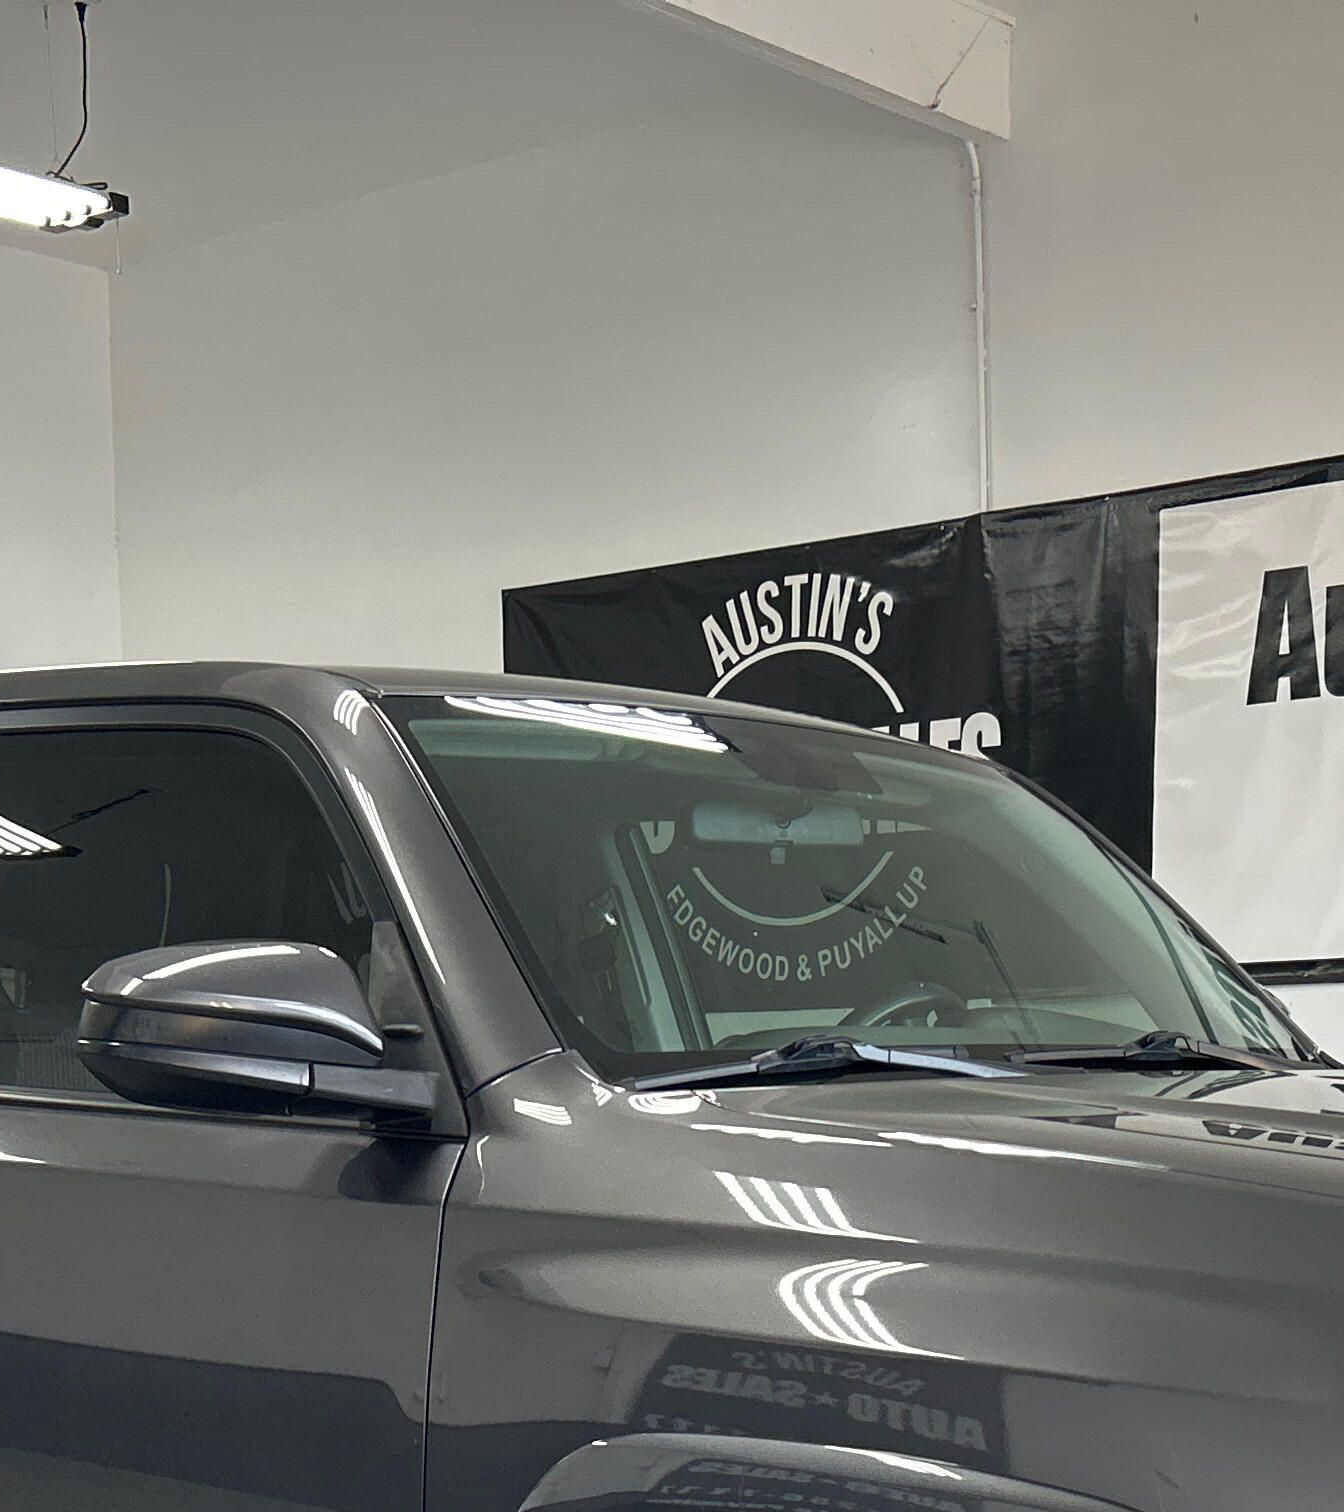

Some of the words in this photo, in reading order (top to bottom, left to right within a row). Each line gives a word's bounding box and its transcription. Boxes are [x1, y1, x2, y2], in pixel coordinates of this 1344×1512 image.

[701, 572, 894, 678] AUSTIN'S
[796, 954, 813, 981] &
[817, 866, 928, 977] PUYALLUP
